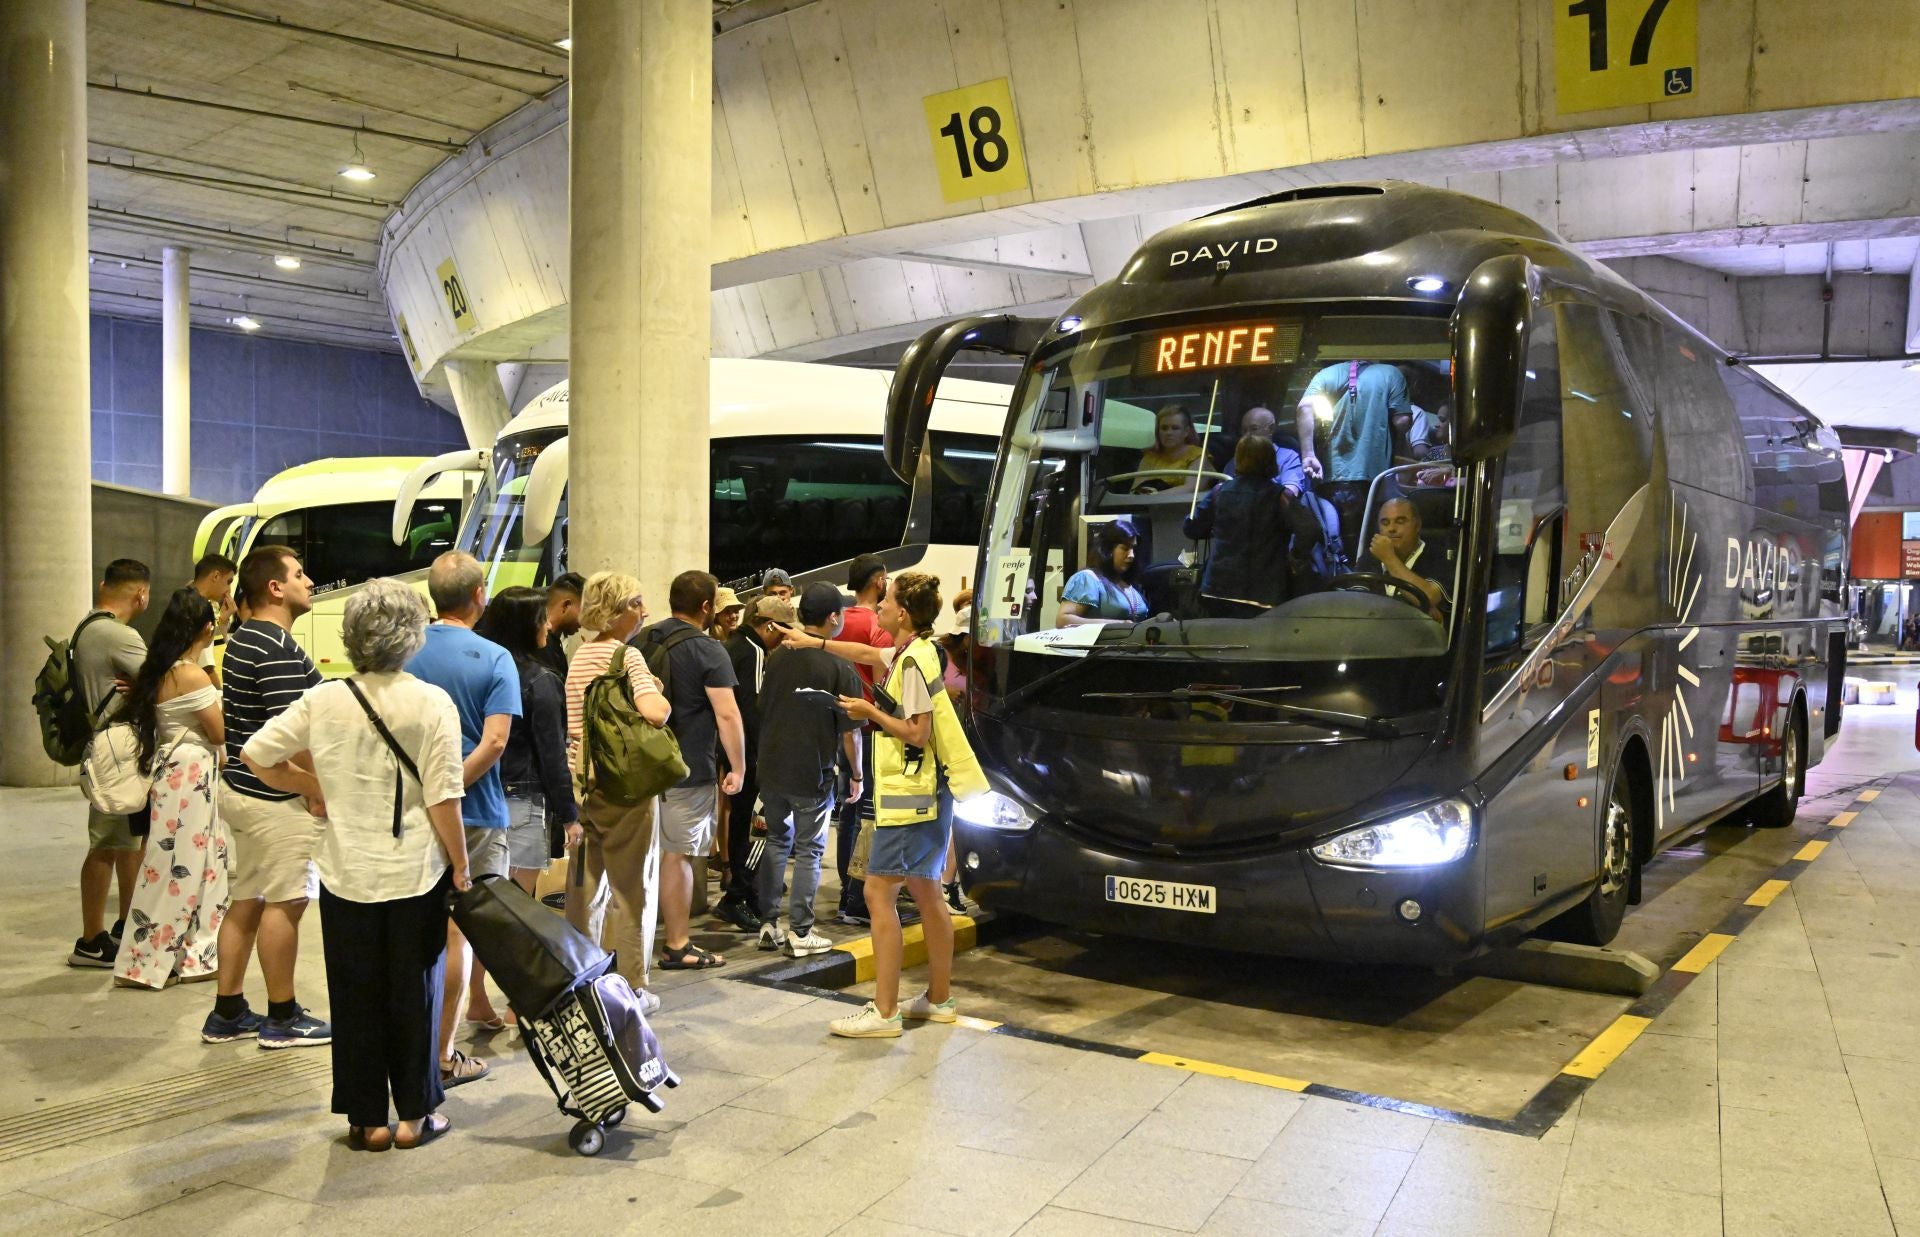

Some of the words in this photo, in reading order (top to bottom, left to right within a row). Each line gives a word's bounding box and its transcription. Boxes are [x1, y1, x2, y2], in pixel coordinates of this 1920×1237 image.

[1568, 0, 1669, 72] 17
[940, 105, 1009, 178] 18
[1170, 238, 1278, 267] DAVID
[444, 275, 467, 319] 20
[1157, 327, 1275, 372] RENFE
[1002, 559, 1025, 571] renfe
[1725, 537, 1789, 591] DAVID
[1002, 572, 1016, 602] 1
[1119, 880, 1166, 904] 0625
[1173, 886, 1210, 909] HXM
